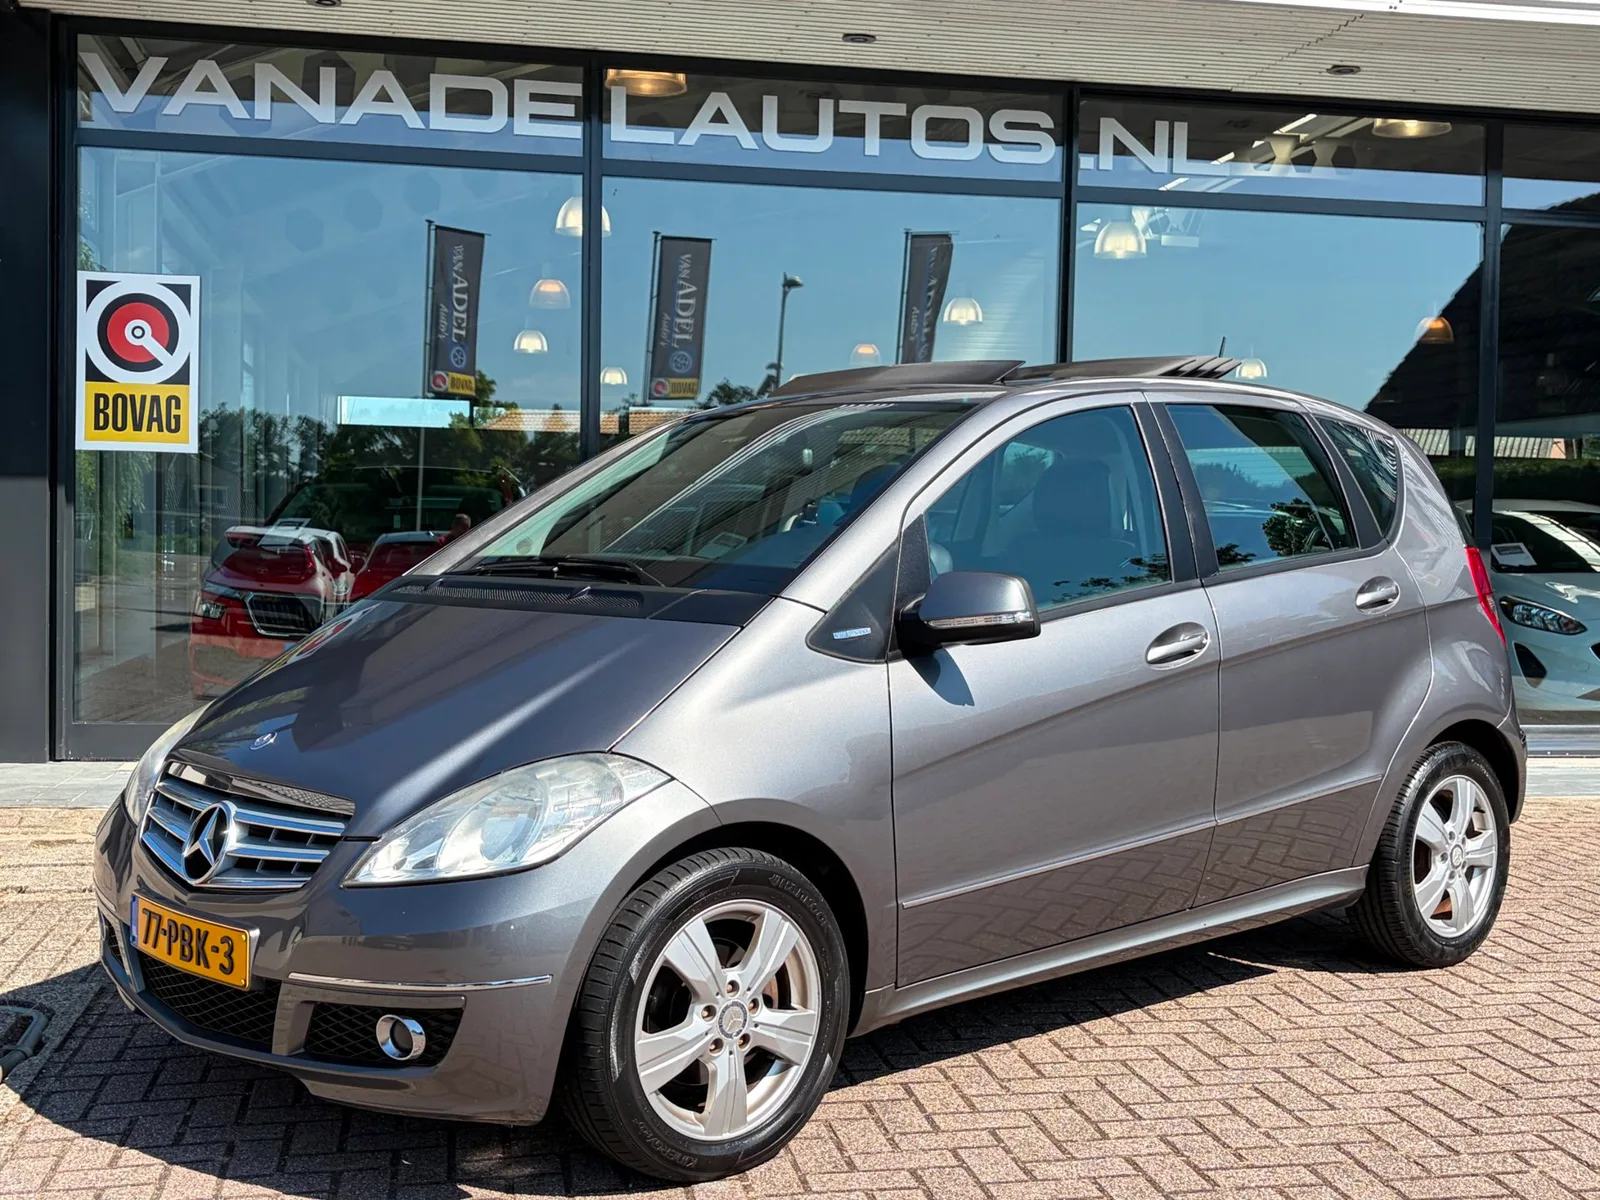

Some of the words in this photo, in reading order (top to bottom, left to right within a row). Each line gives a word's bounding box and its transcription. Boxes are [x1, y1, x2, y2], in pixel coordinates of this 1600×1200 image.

[679, 254, 692, 279] VAN
[452, 273, 469, 343] ADEL
[672, 280, 697, 348] ADEL
[450, 377, 474, 391] BOVAG
[94, 392, 181, 433] BOVAG
[142, 908, 234, 975] 77-PBK-3
